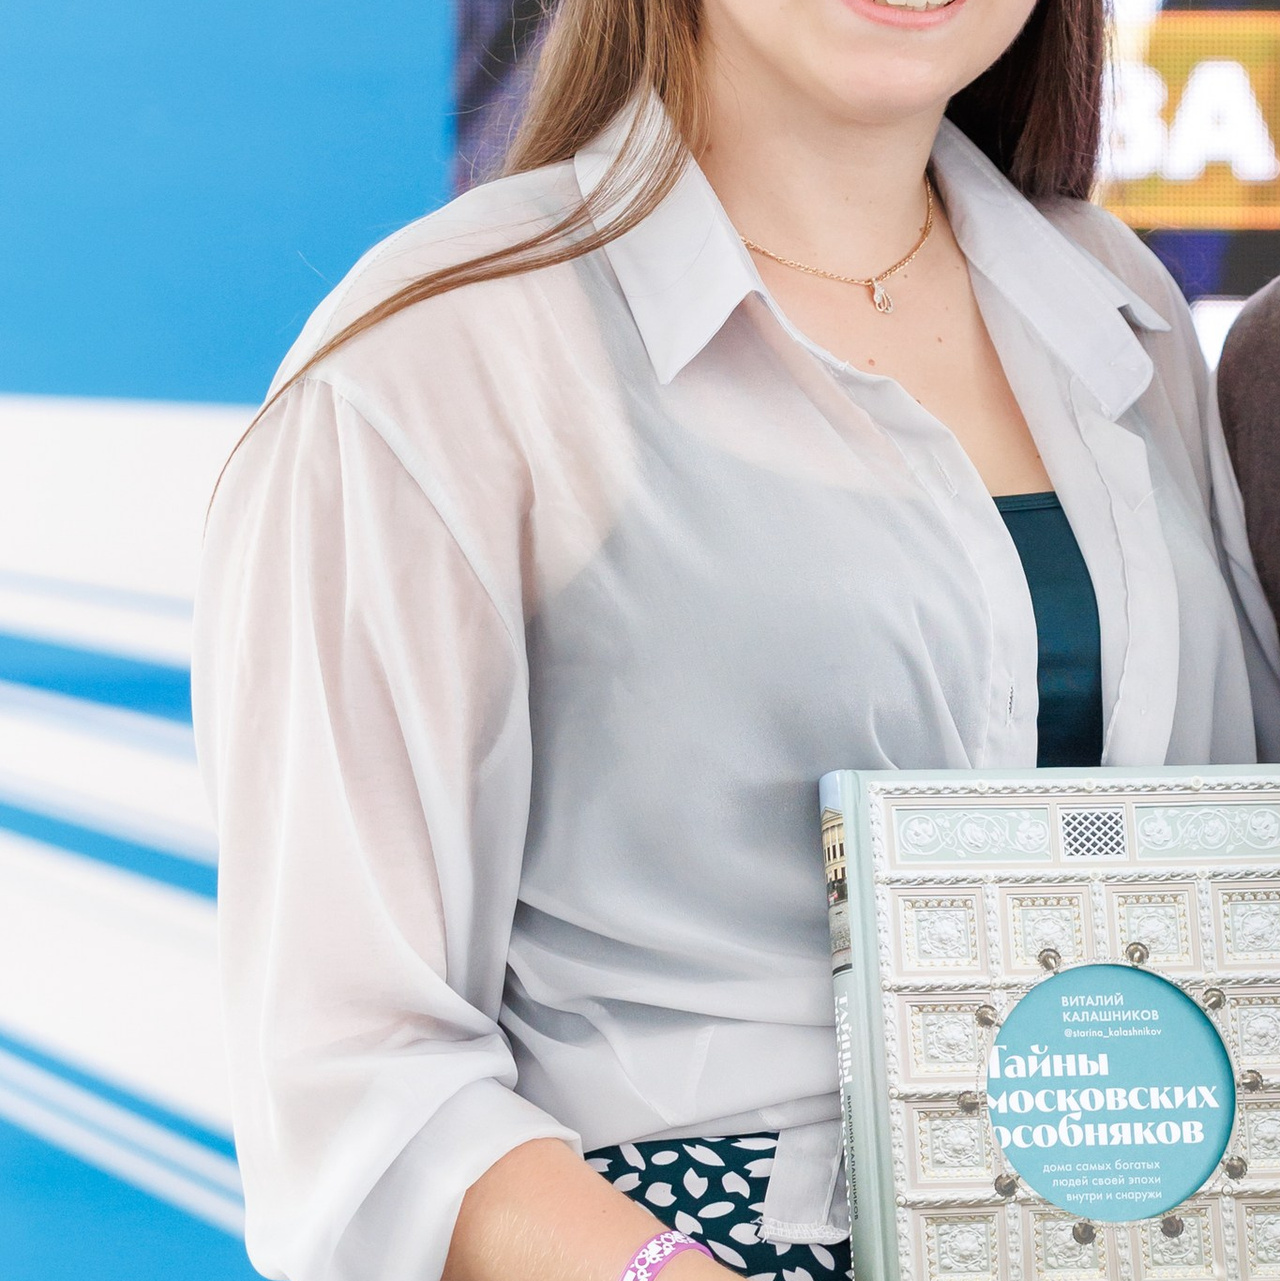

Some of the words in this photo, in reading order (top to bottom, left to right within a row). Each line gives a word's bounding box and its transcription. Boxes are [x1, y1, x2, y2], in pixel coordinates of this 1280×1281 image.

[1061, 993, 1124, 1007] ВИТАЛИЙ
[1063, 1010, 1159, 1023] КАЛАШНИКОВ
[839, 991, 853, 1084] ТАЙНЫ
[1064, 1027, 1162, 1038] @starina_kalashnikov
[988, 1044, 1109, 1079] Тайны
[986, 1085, 1220, 1114] московских
[992, 1110, 1205, 1149] особняков
[1043, 1163, 1072, 1174] дома
[1076, 1162, 1112, 1171] самых
[1115, 1159, 1161, 1171] богатых
[850, 1145, 859, 1221] КАЛАШНИКОВ
[1053, 1175, 1089, 1187] людей
[1092, 1175, 1125, 1186] своей
[1128, 1175, 1161, 1186] эпохи
[1066, 1191, 1103, 1204] внутри
[1106, 1192, 1113, 1201] и
[1115, 1190, 1163, 1204] снаружи
